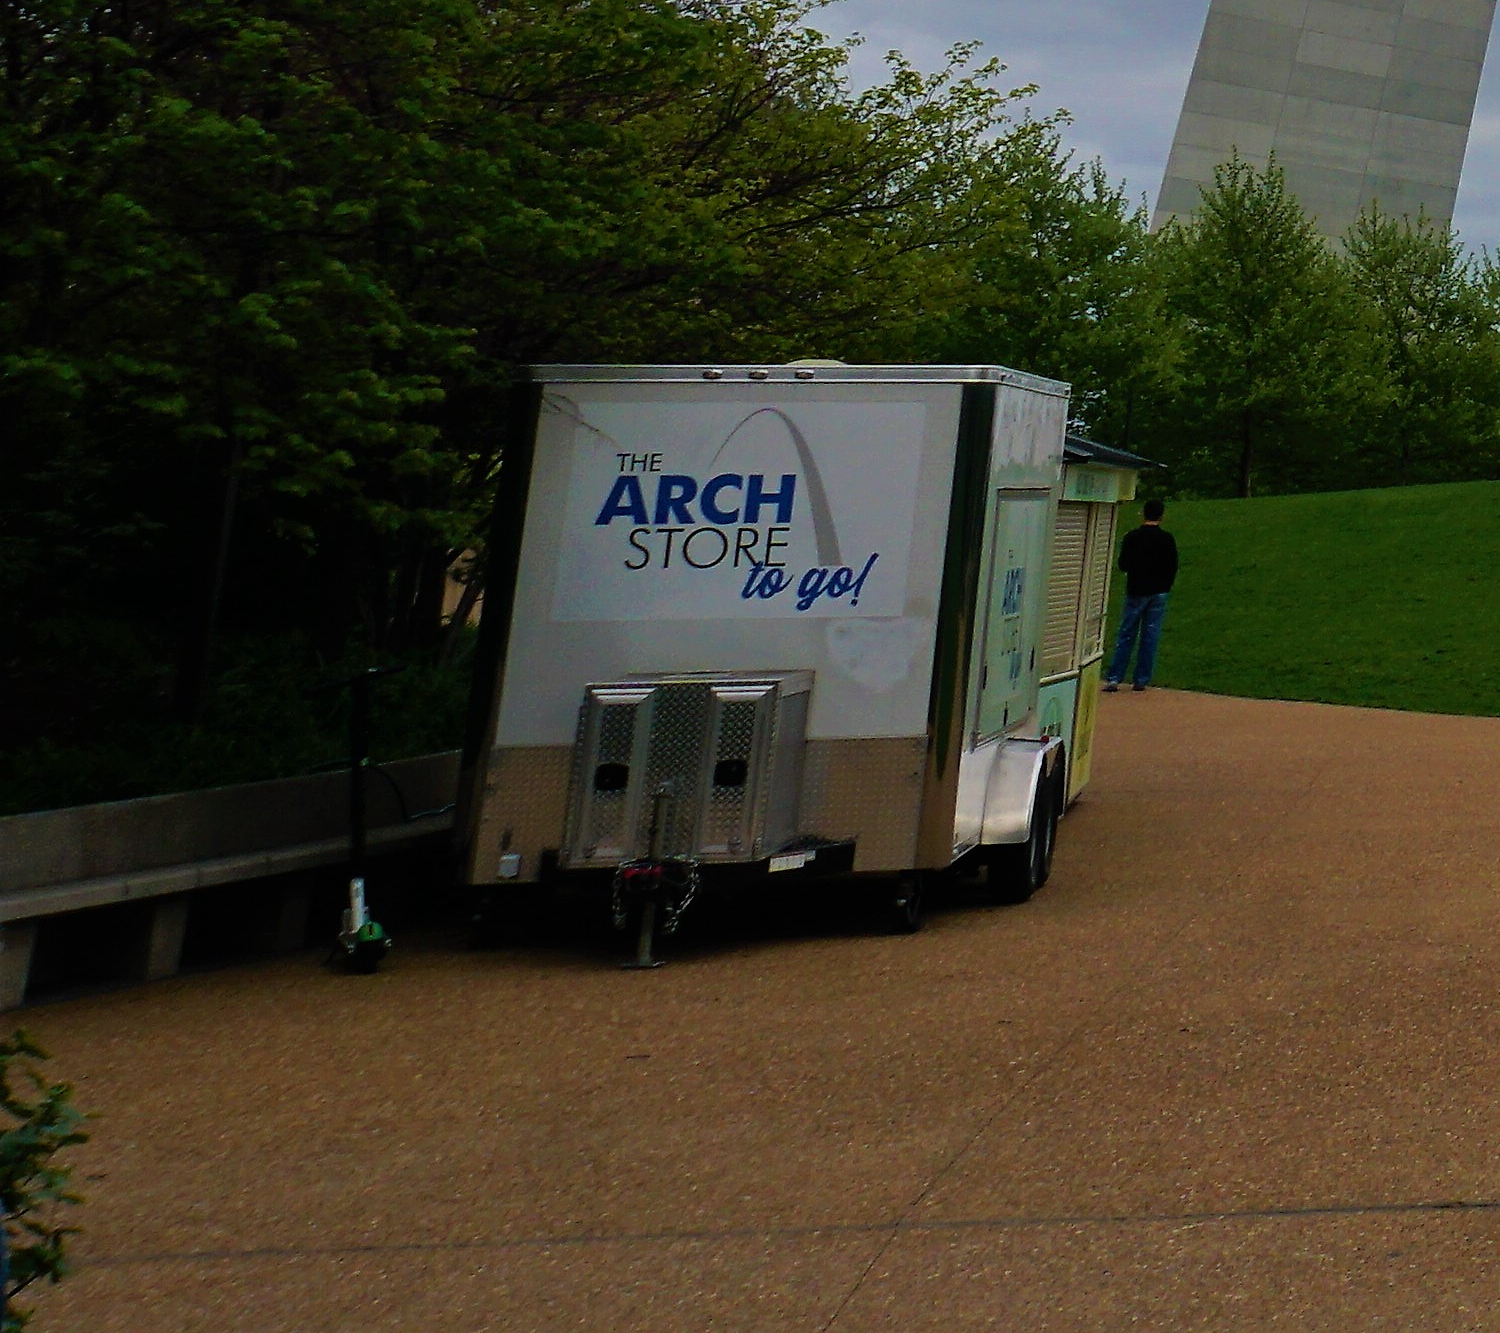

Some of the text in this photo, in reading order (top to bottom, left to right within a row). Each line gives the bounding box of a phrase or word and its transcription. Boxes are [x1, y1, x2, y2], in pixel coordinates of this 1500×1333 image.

[616, 453, 663, 472] THE
[595, 473, 797, 525] ARCH
[624, 527, 790, 570] STORE
[741, 552, 880, 612] to go!
